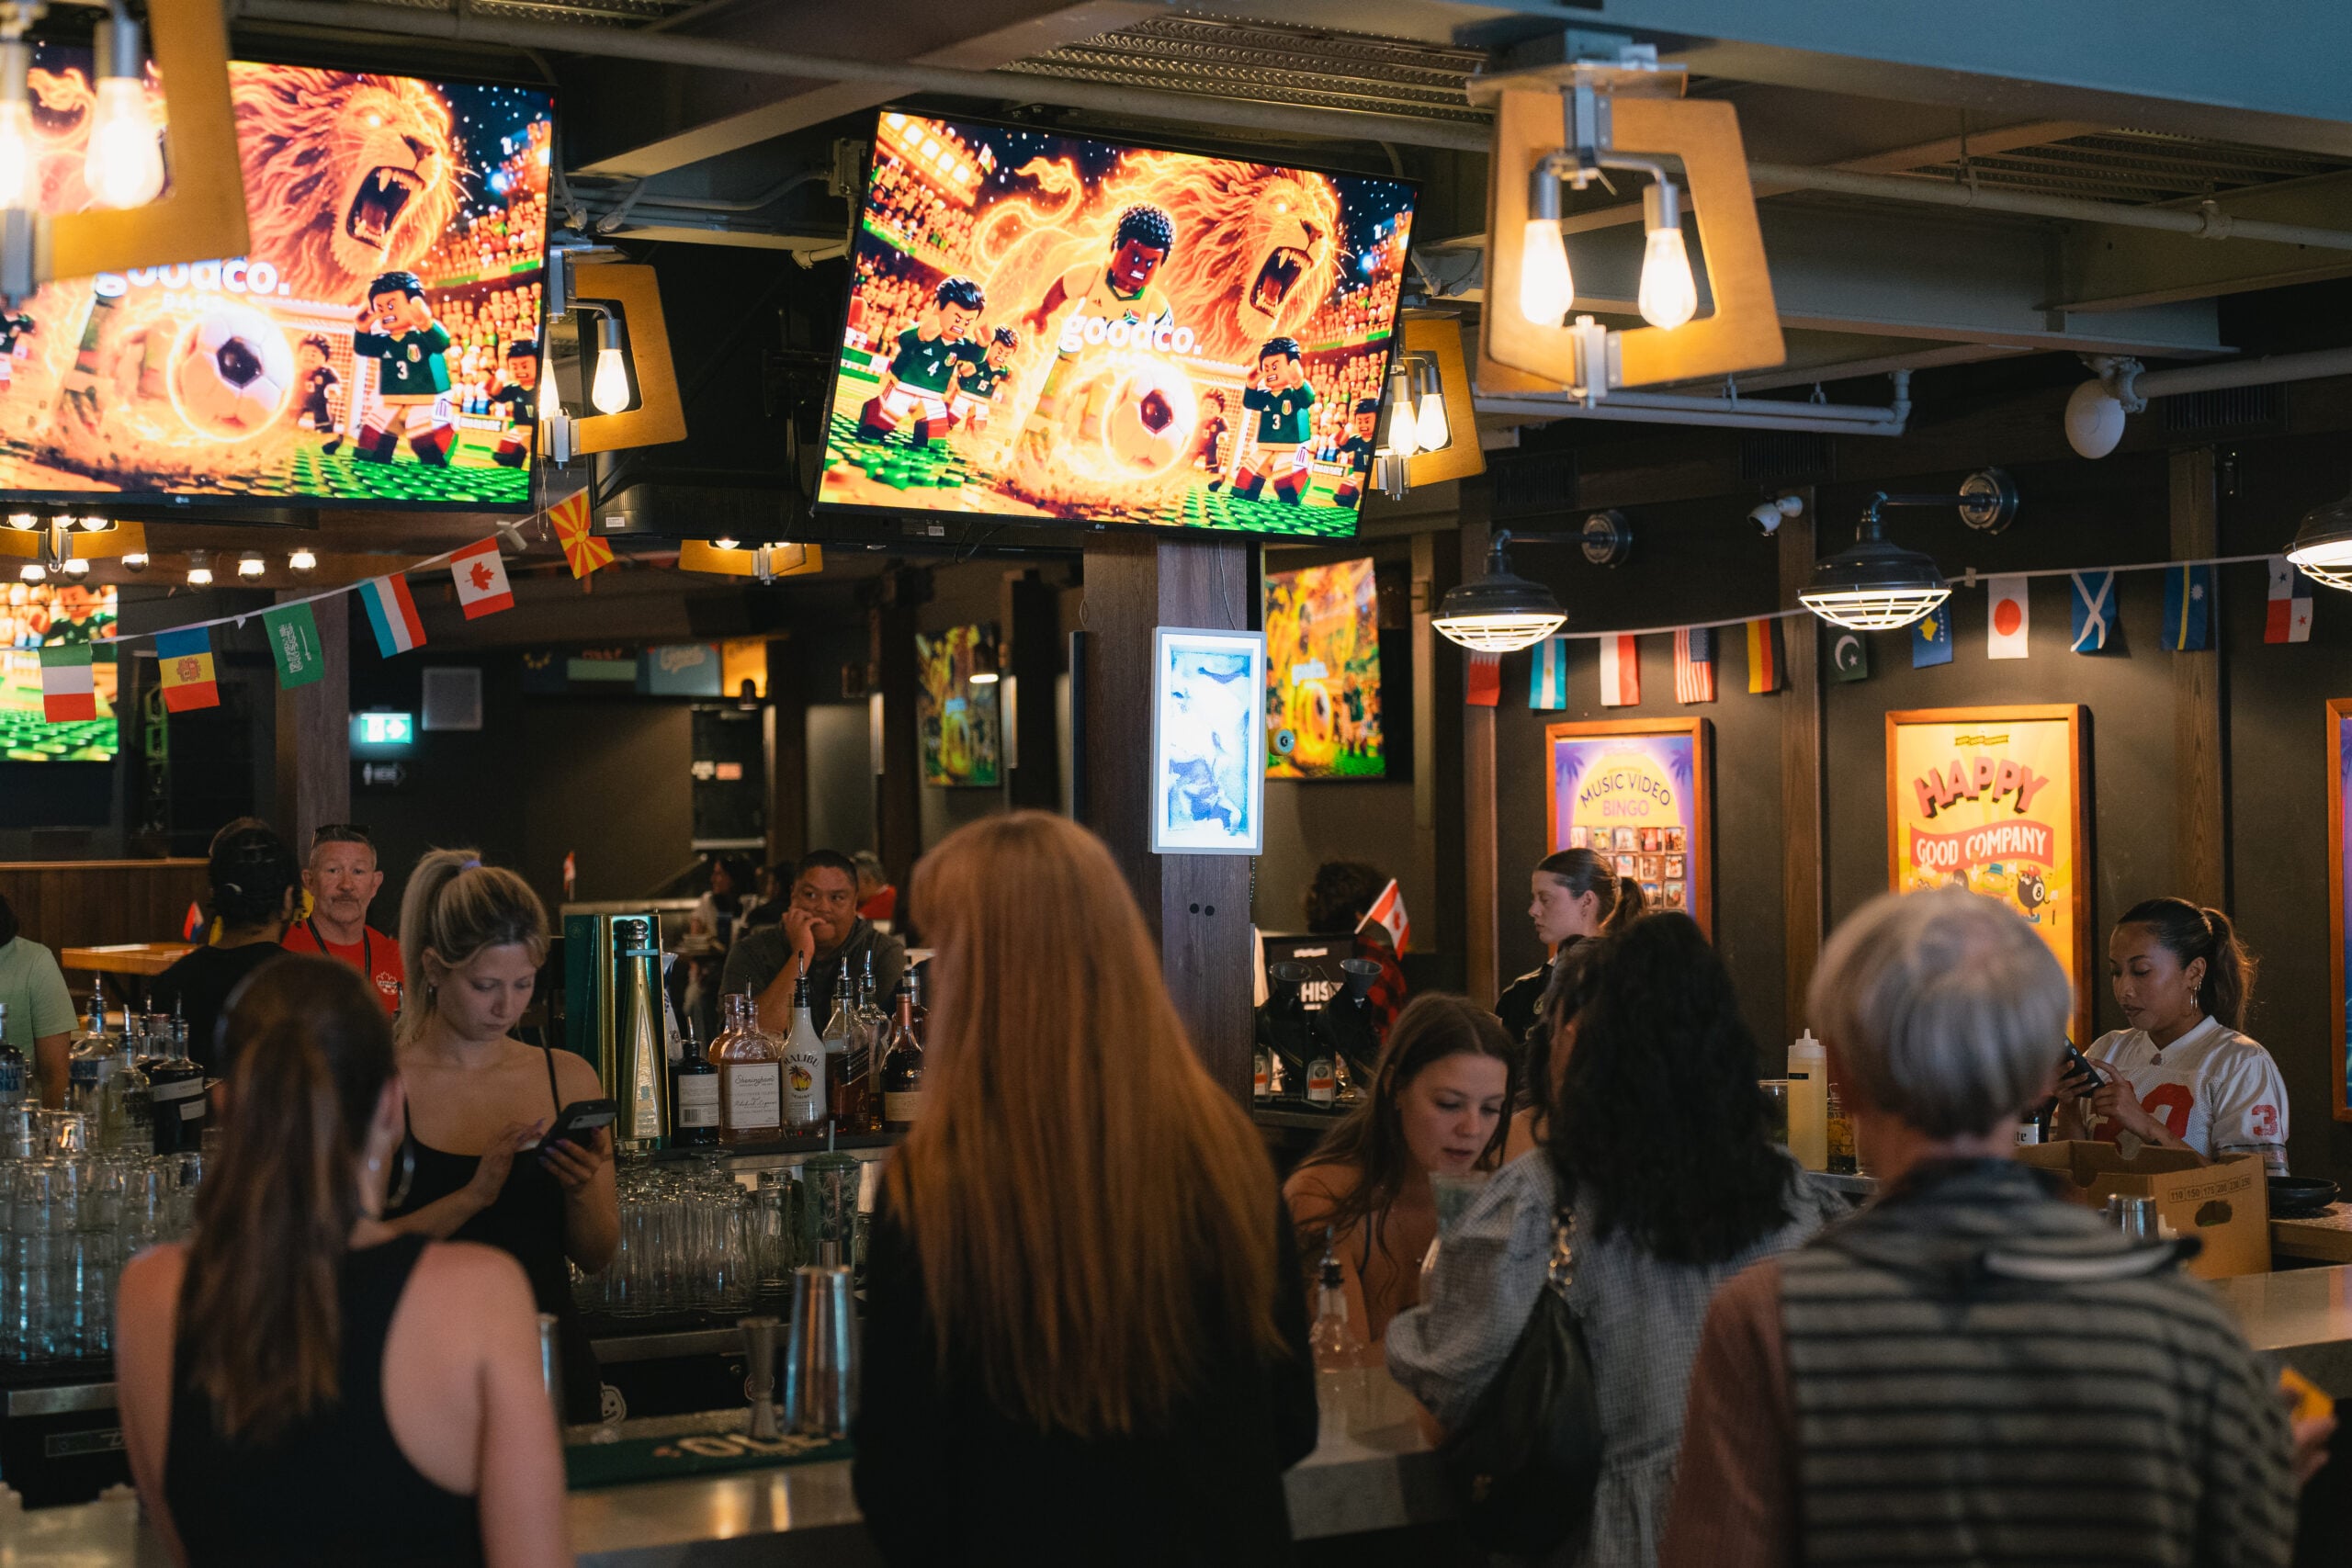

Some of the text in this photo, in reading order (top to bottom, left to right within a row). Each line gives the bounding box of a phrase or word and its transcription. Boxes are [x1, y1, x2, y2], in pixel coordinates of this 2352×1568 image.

[1059, 312, 1203, 355] goodco.
[396, 360, 409, 379] 3
[926, 360, 940, 378] 4
[1272, 413, 1282, 431] 3
[1580, 773, 1670, 808] MUSIC VIDEO
[1914, 756, 2050, 818] HAPPY
[1602, 799, 1649, 817] BINGO
[1917, 826, 2047, 866] GOOD COMPANY
[2036, 886, 2041, 897] 8
[784, 1054, 820, 1067] MALIBU
[2252, 1104, 2278, 1136] 3
[2170, 1190, 2184, 1201] 110
[2187, 1189, 2200, 1199] 150
[2203, 1186, 2215, 1196] 175
